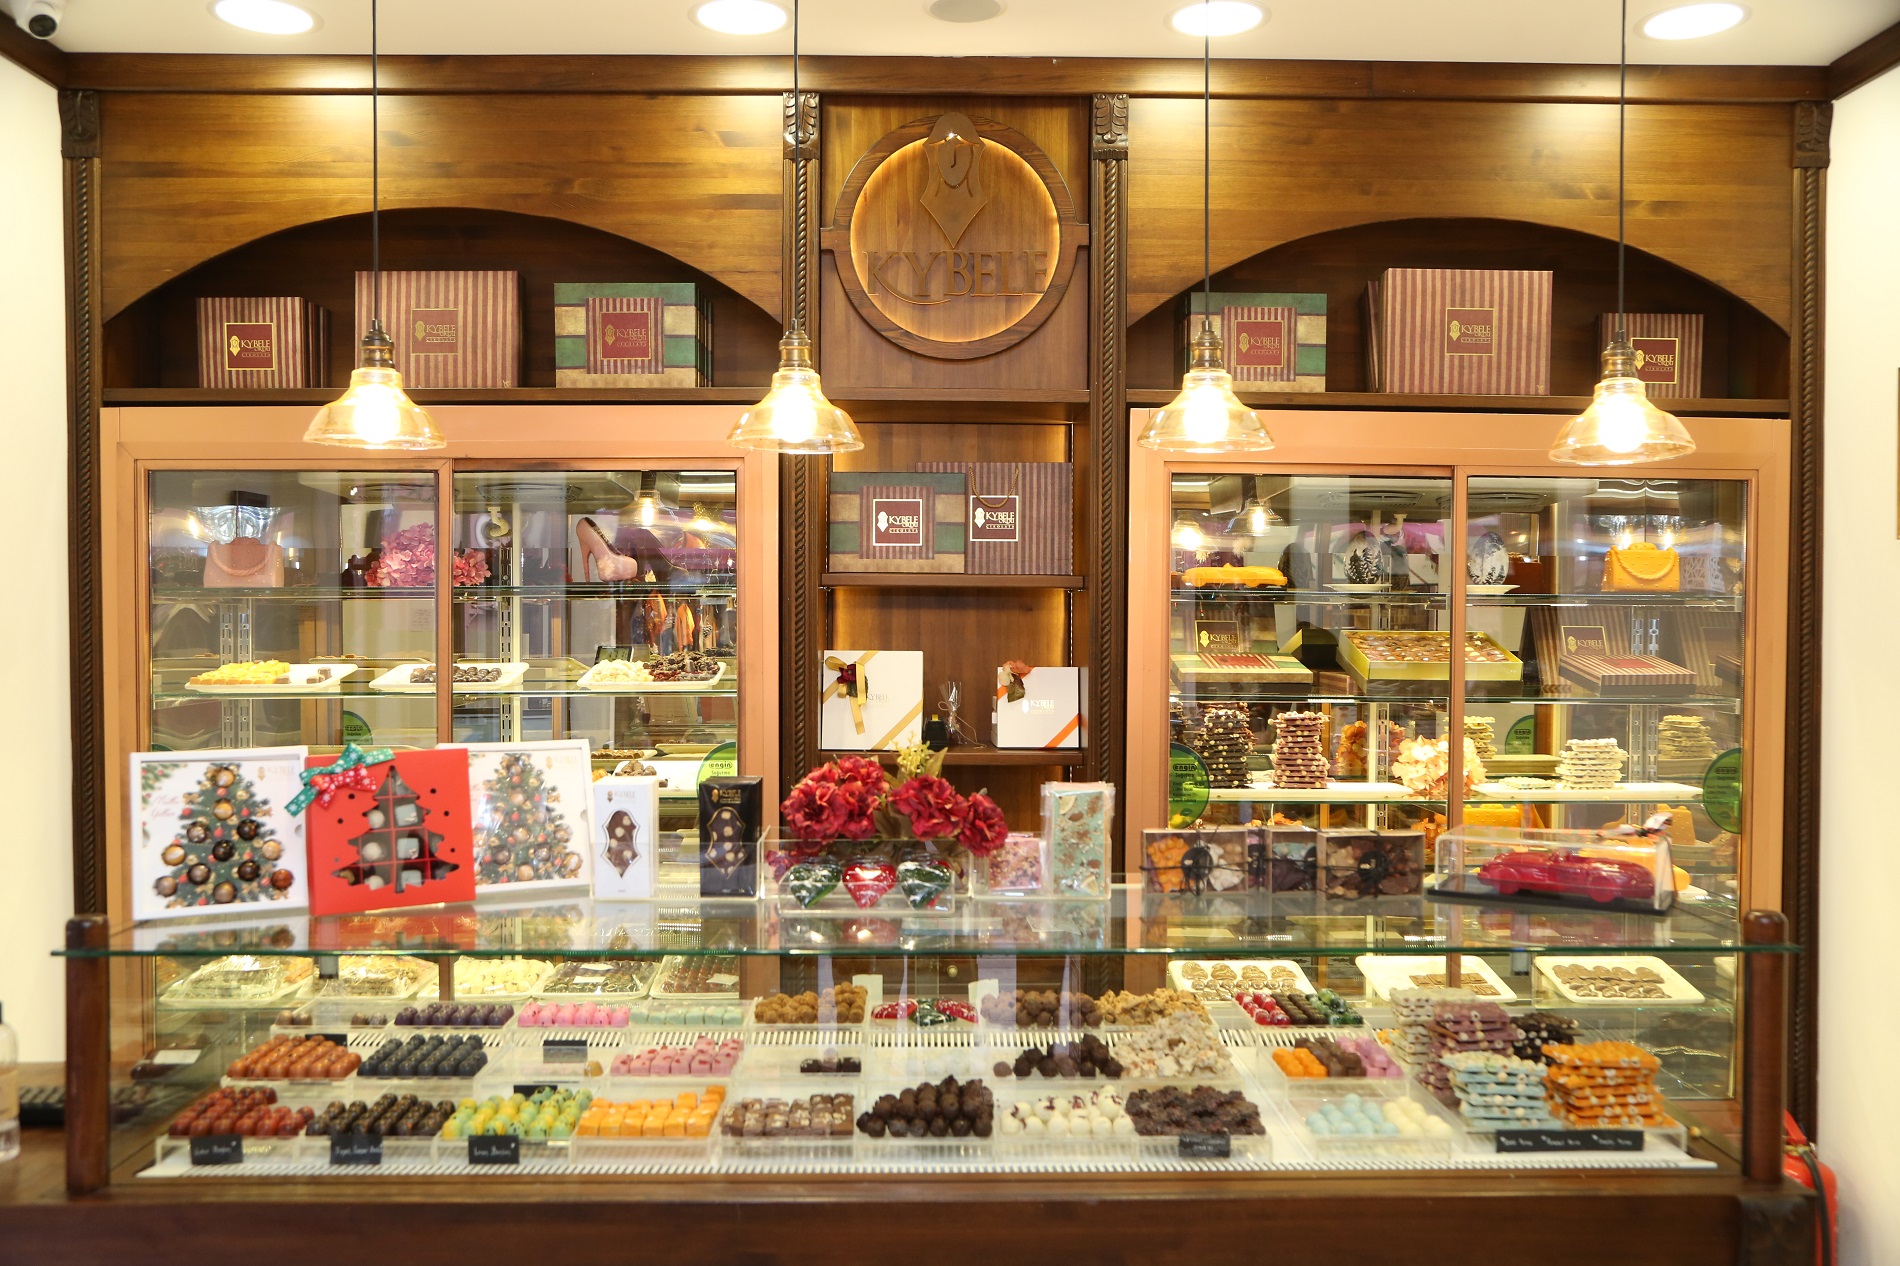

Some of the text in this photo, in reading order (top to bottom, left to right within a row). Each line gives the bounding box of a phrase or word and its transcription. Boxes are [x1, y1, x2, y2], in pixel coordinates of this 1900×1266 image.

[862, 250, 1048, 305] KYBELE
[426, 324, 456, 333] KYBELE
[616, 328, 646, 338] KYBELE
[1461, 324, 1490, 334] KYBELE
[241, 339, 270, 348] KYBELE
[1250, 337, 1280, 346] KYBELE
[1645, 354, 1674, 363] KYBELE
[888, 515, 919, 525] KYBELE
[985, 511, 1015, 521] KYBELE
[710, 760, 731, 768] engin
